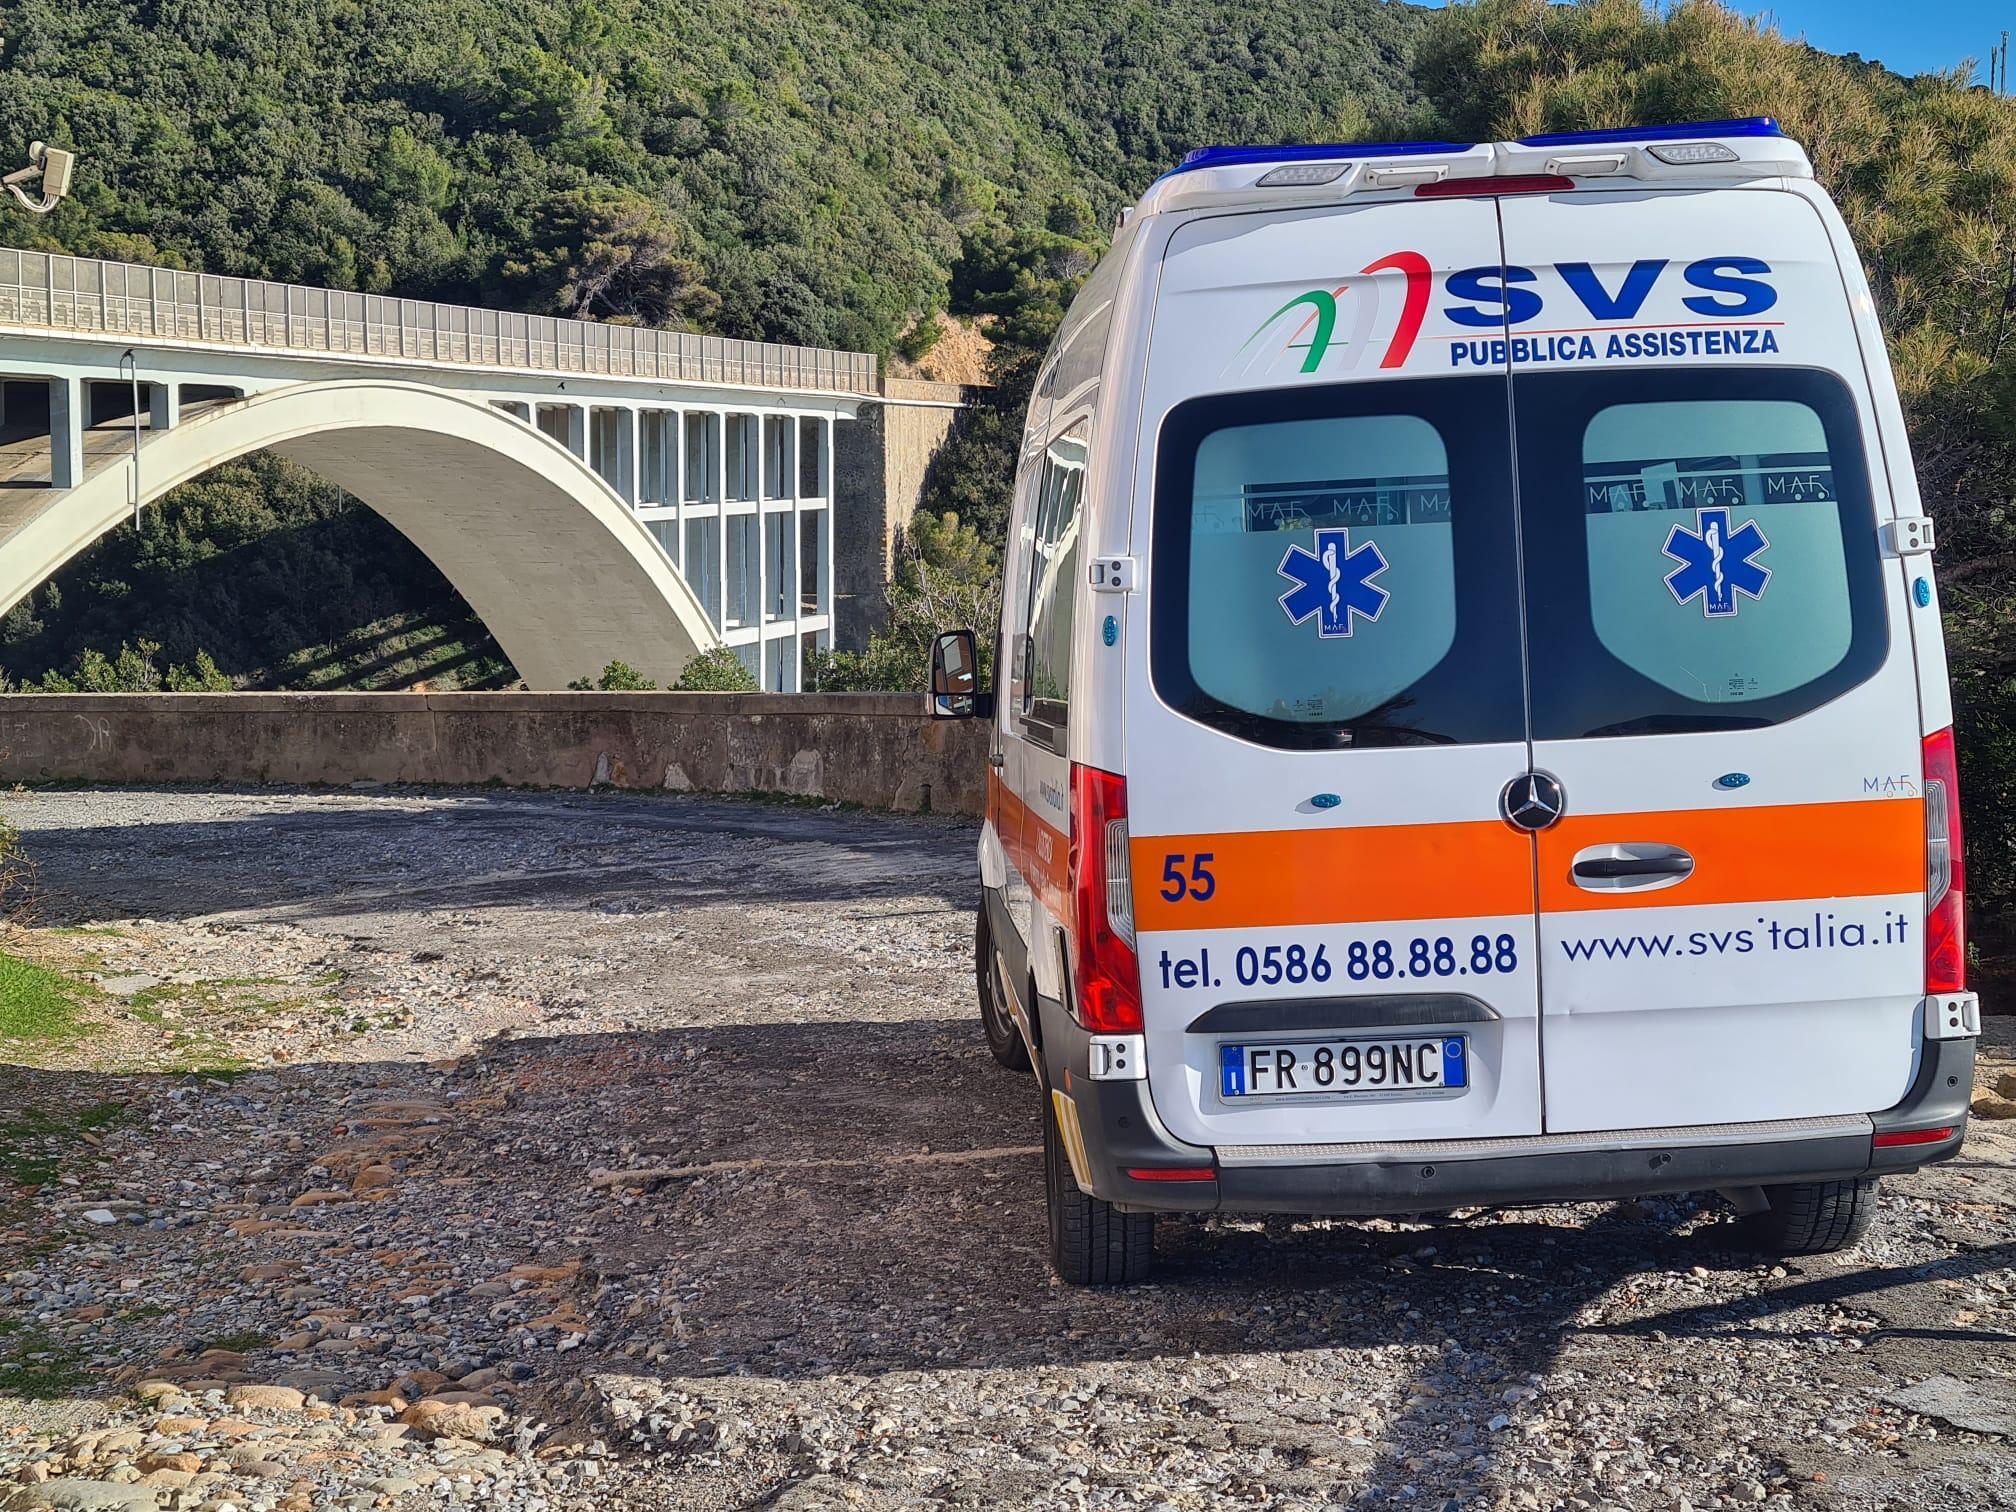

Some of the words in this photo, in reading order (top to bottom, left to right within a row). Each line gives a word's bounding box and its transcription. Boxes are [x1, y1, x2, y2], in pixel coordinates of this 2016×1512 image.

[1443, 256, 1778, 327] SVS
[1450, 335, 1597, 367] PUBBLICA
[1607, 329, 1779, 360] ASSISTENZA
[1160, 852, 1216, 903] 55
[1159, 948, 1221, 989] tel.
[1236, 943, 1332, 986] 0586
[1347, 933, 1518, 980] 88.88.88
[1560, 910, 1909, 962] www.svstalia.it
[1250, 1050, 1298, 1090] FR
[1314, 1043, 1439, 1086] 899NC
